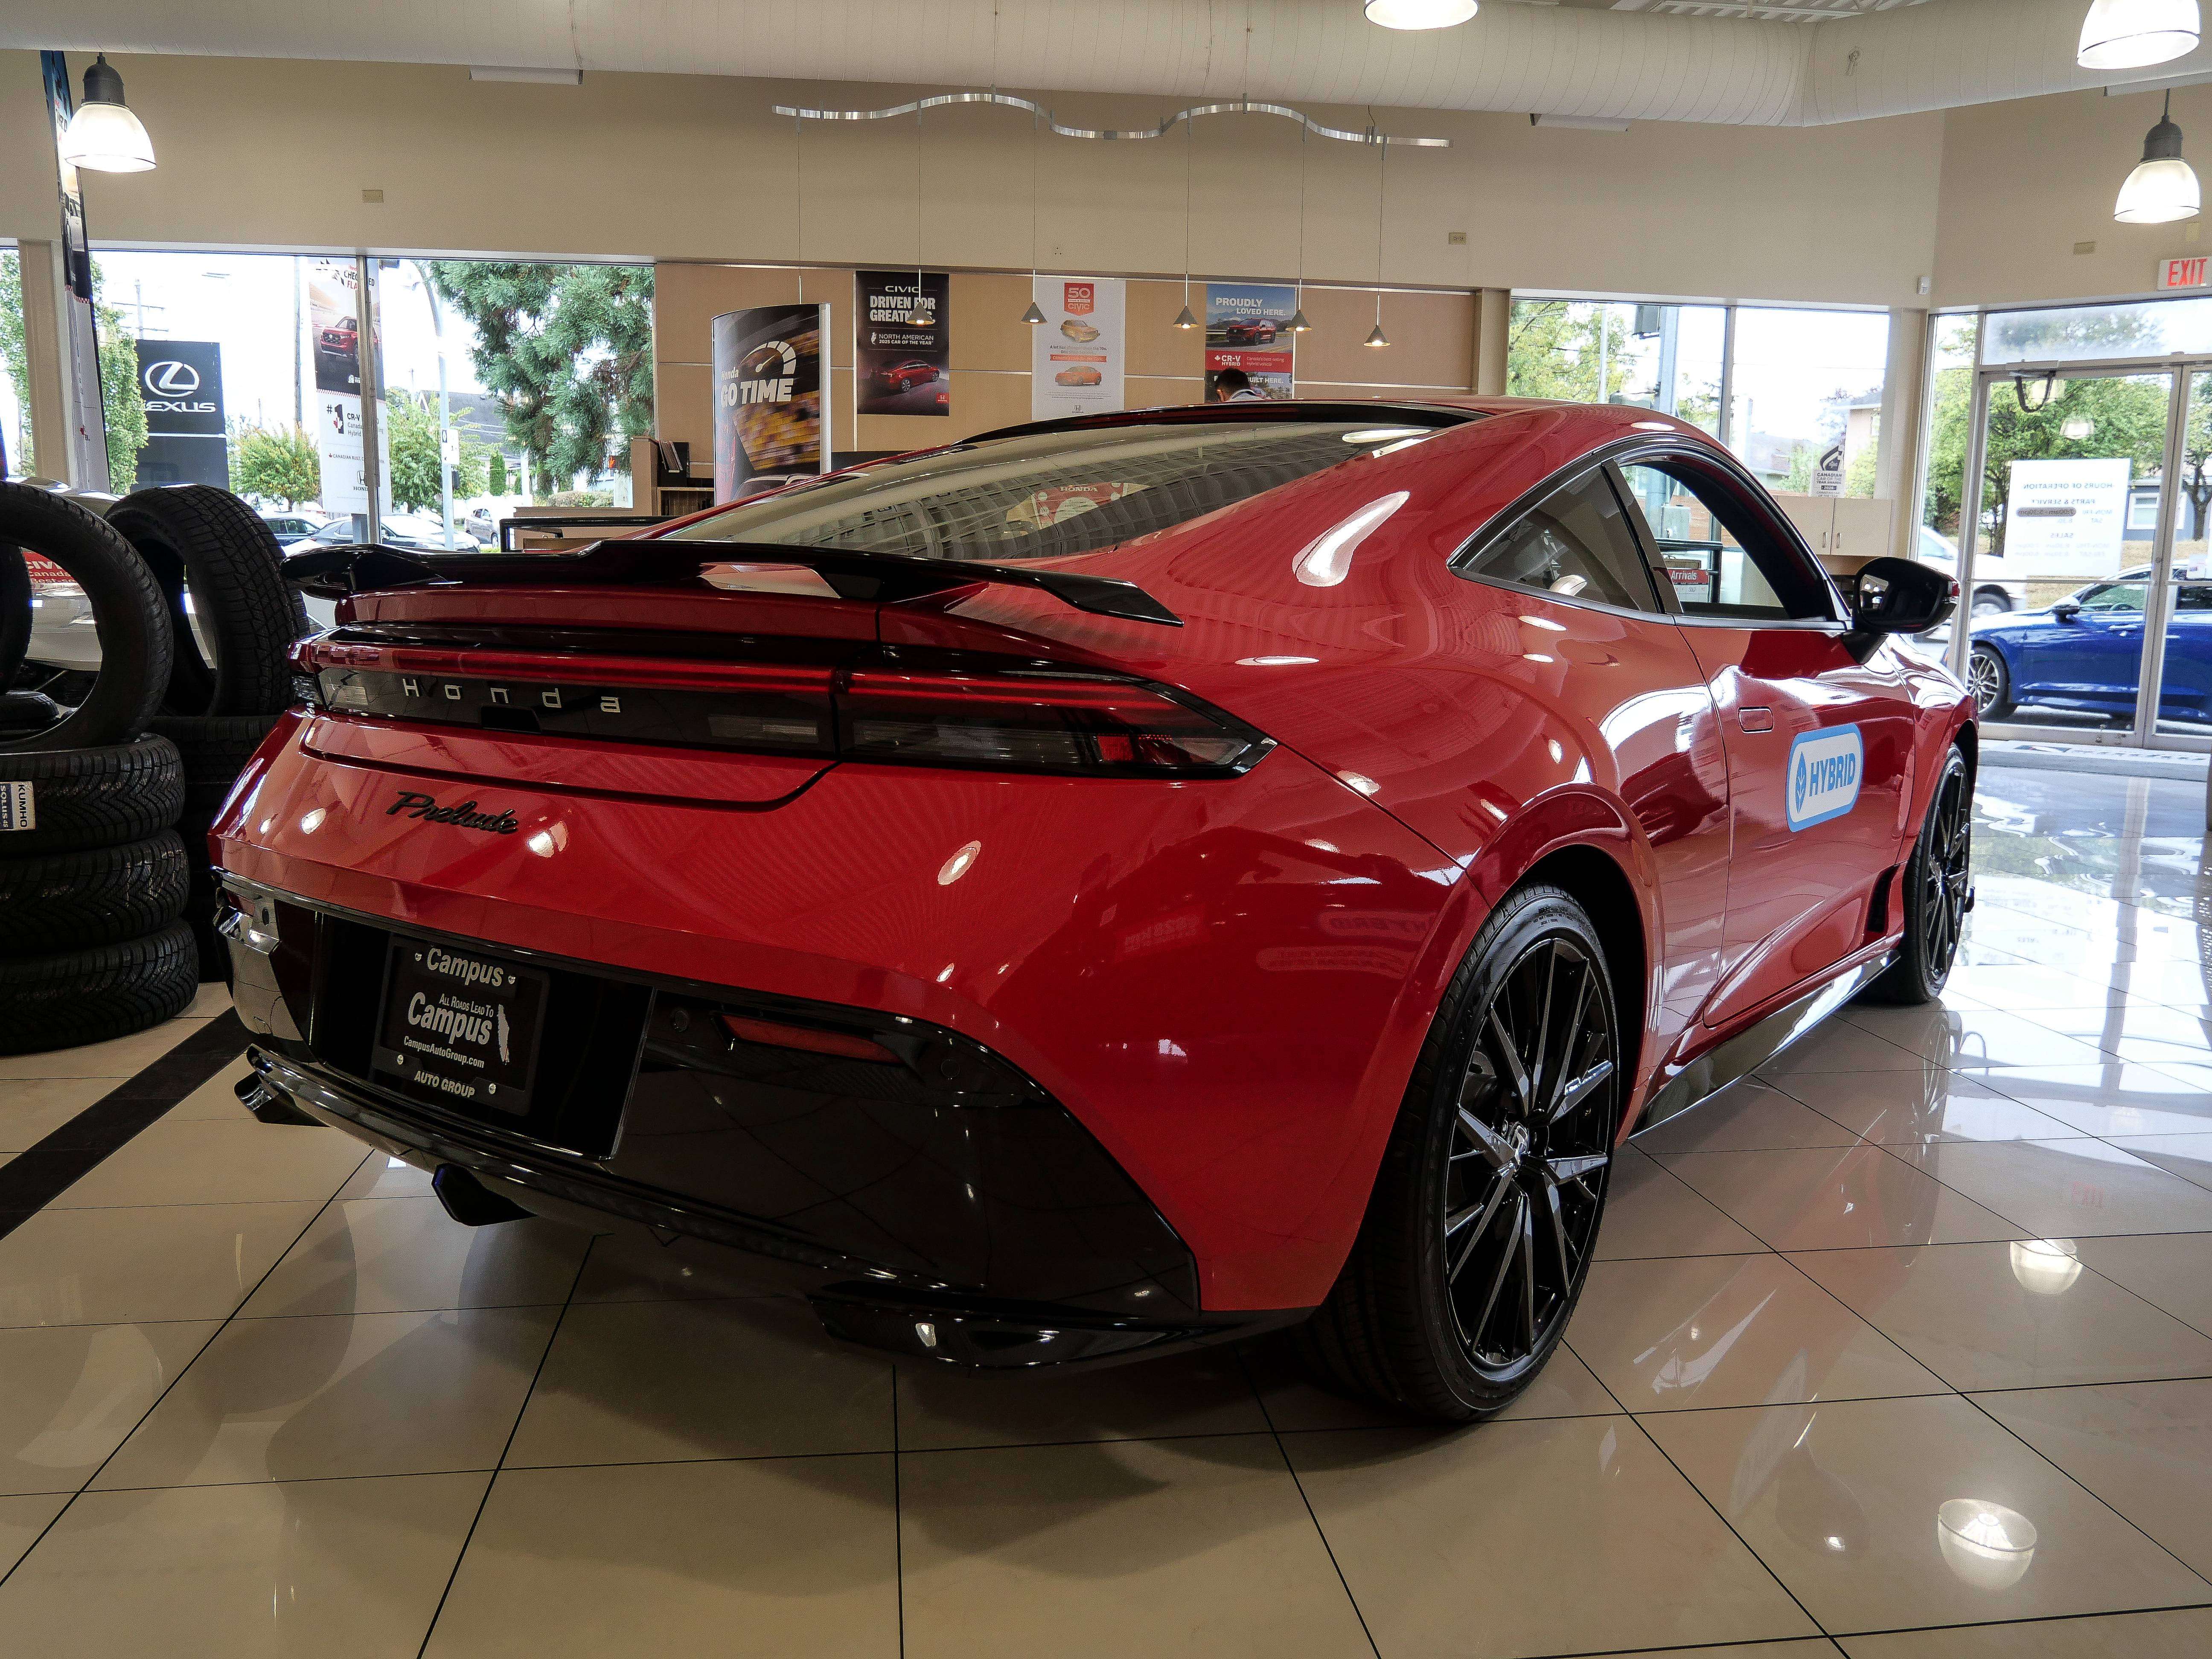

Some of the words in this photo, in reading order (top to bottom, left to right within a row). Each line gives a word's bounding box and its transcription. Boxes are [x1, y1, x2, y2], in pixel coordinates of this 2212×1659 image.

[347, 280, 358, 289] FLA
[2167, 258, 2207, 286] EXIT
[870, 296, 911, 309] DRIVEN
[914, 297, 935, 309] FOR
[1068, 288, 1090, 298] 50
[1216, 297, 1263, 307] PROUDLY
[138, 401, 216, 413] EXUS
[721, 383, 738, 408] GO
[740, 378, 794, 404] TIME
[347, 413, 360, 421] CR-V
[1671, 570, 1697, 580] Arrivals
[403, 678, 621, 713] Honda
[1809, 753, 1856, 797] HYBRID
[18, 784, 27, 827] KUMHO
[386, 790, 519, 834] Prelude
[427, 948, 504, 987] Campus
[408, 992, 492, 1045] Campus
[404, 1036, 485, 1068] CampusAutoGroup.com
[414, 1070, 439, 1087] AUTO
[441, 1079, 475, 1098] GROUP
